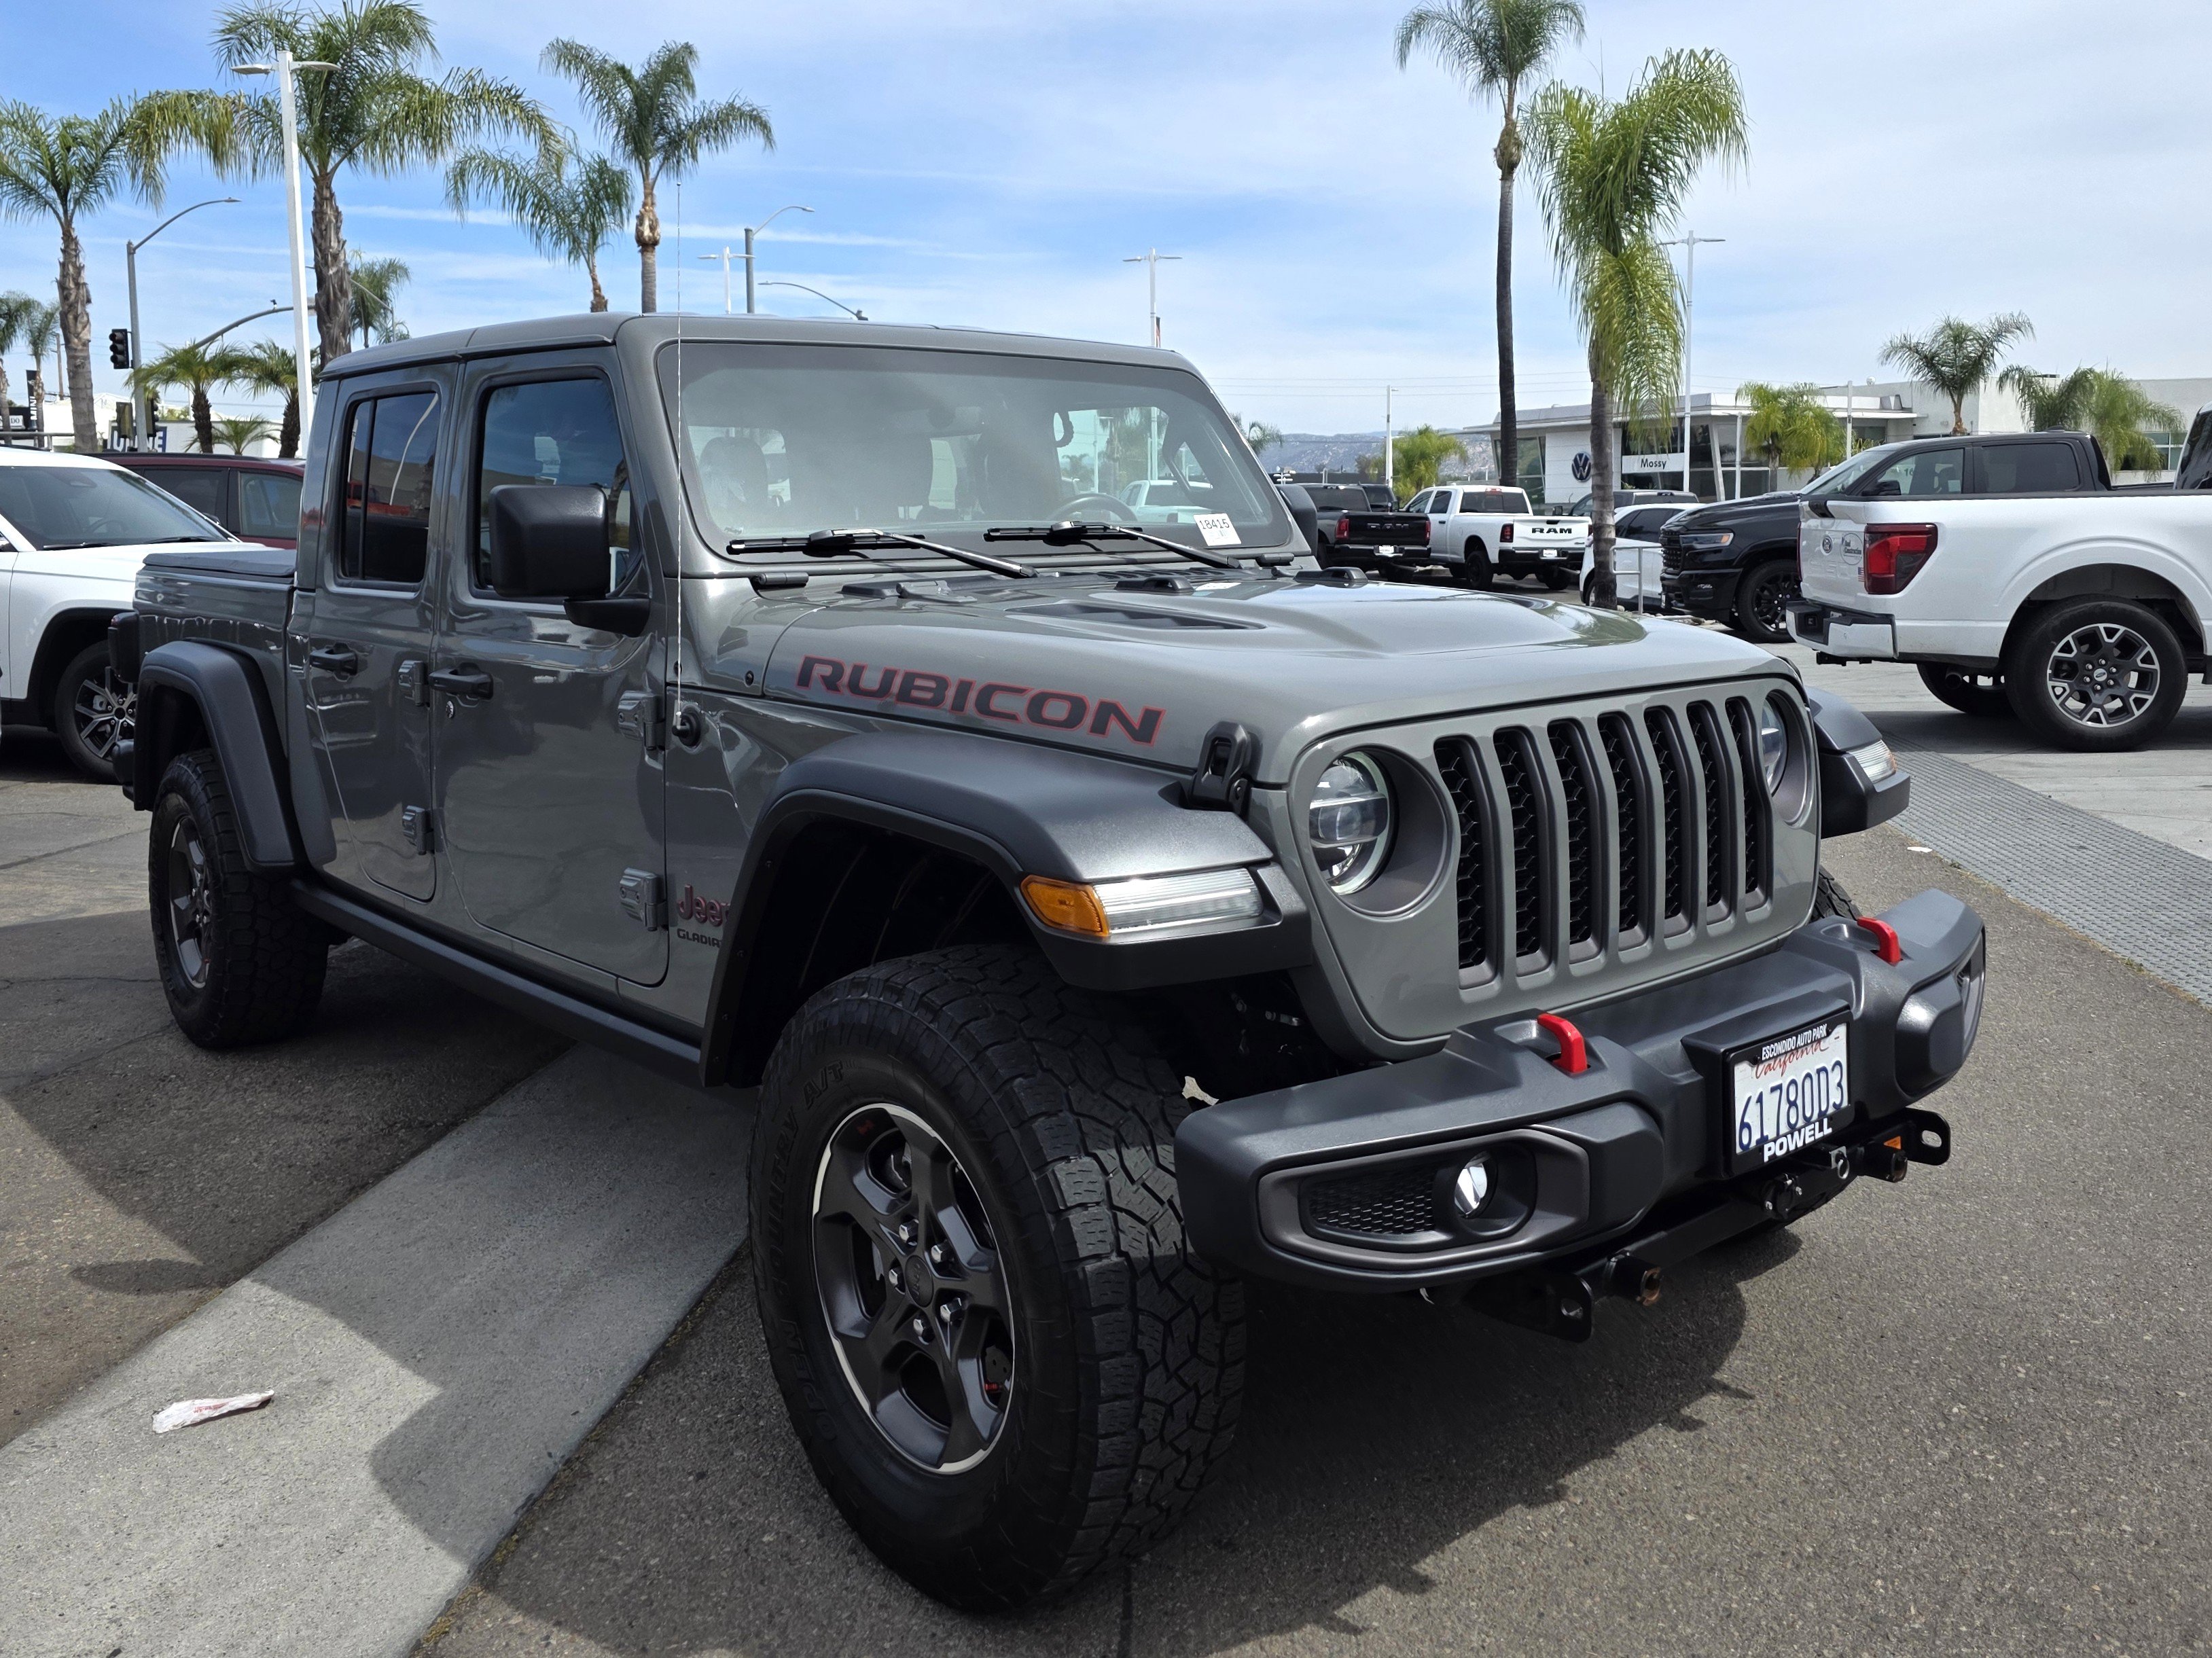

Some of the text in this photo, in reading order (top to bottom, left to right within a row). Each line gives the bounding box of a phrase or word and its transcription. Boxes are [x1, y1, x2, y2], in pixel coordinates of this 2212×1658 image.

[1641, 458, 1666, 470] Mossy
[1199, 519, 1230, 530] 18415
[796, 655, 1166, 747] RUBICON
[677, 928, 722, 948] GLADIA
[1762, 1023, 1827, 1061] ESCONDIDO AUTO PARK
[802, 1059, 844, 1111] A/T
[1738, 1060, 1844, 1151] 61780D3
[1764, 1117, 1832, 1163] POWELL
